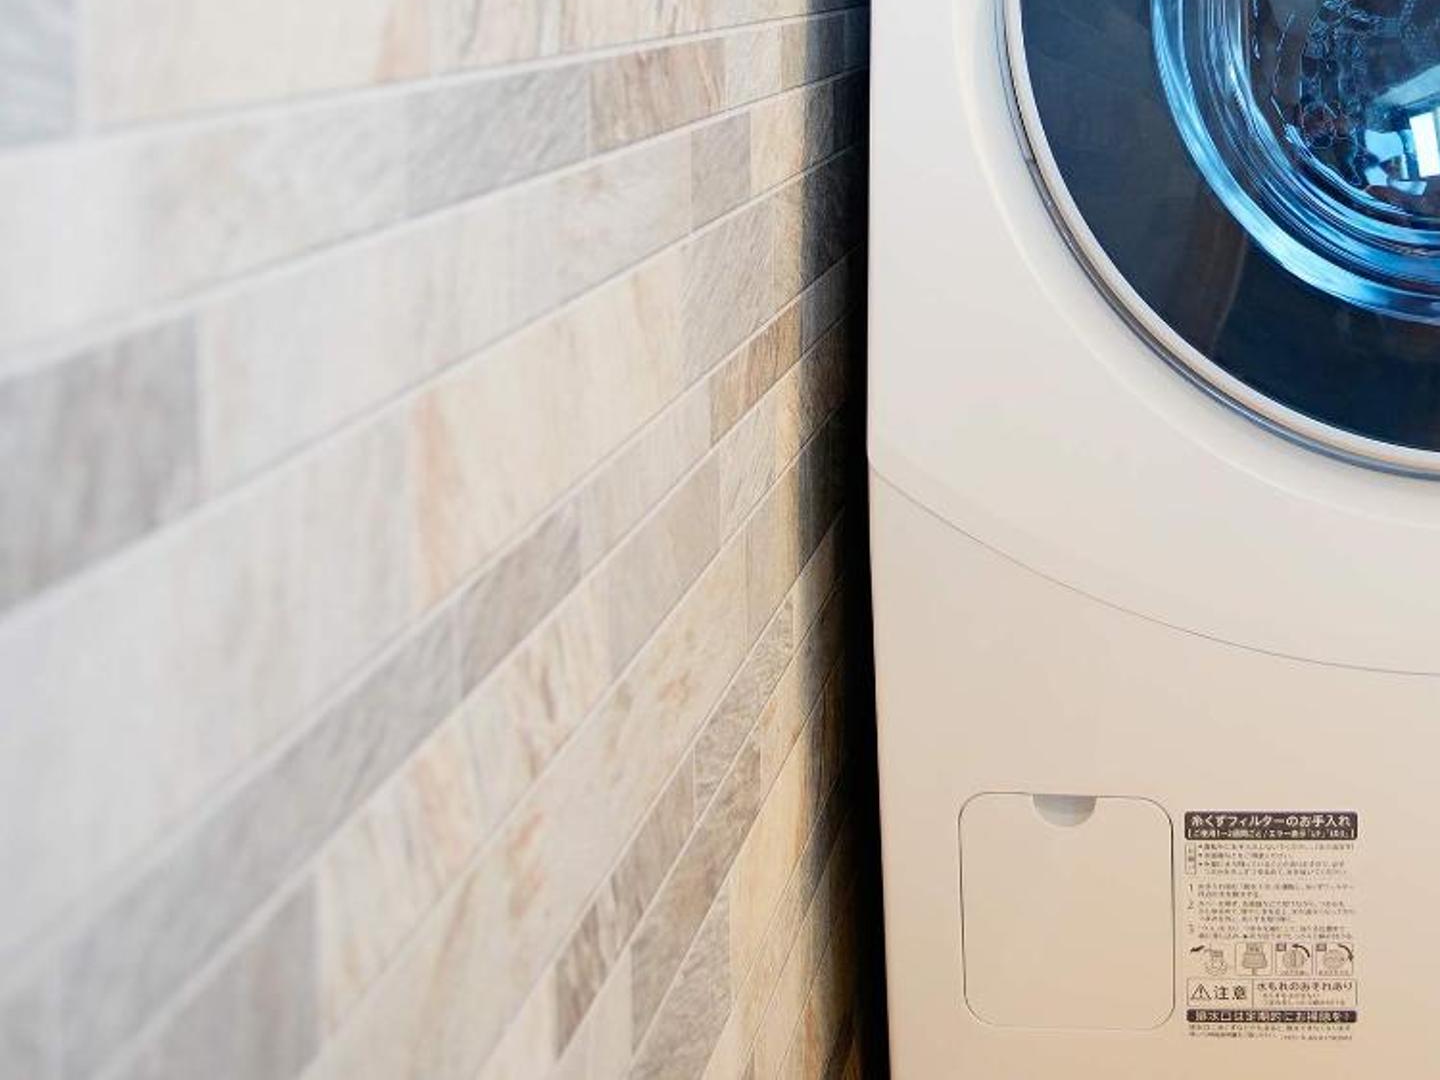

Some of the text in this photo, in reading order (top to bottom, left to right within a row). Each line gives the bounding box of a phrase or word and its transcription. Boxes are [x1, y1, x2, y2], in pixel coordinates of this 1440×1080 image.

[1191, 814, 1351, 828] 糸くずフィルターのお手入れ
[1213, 985, 1248, 1001] 注意
